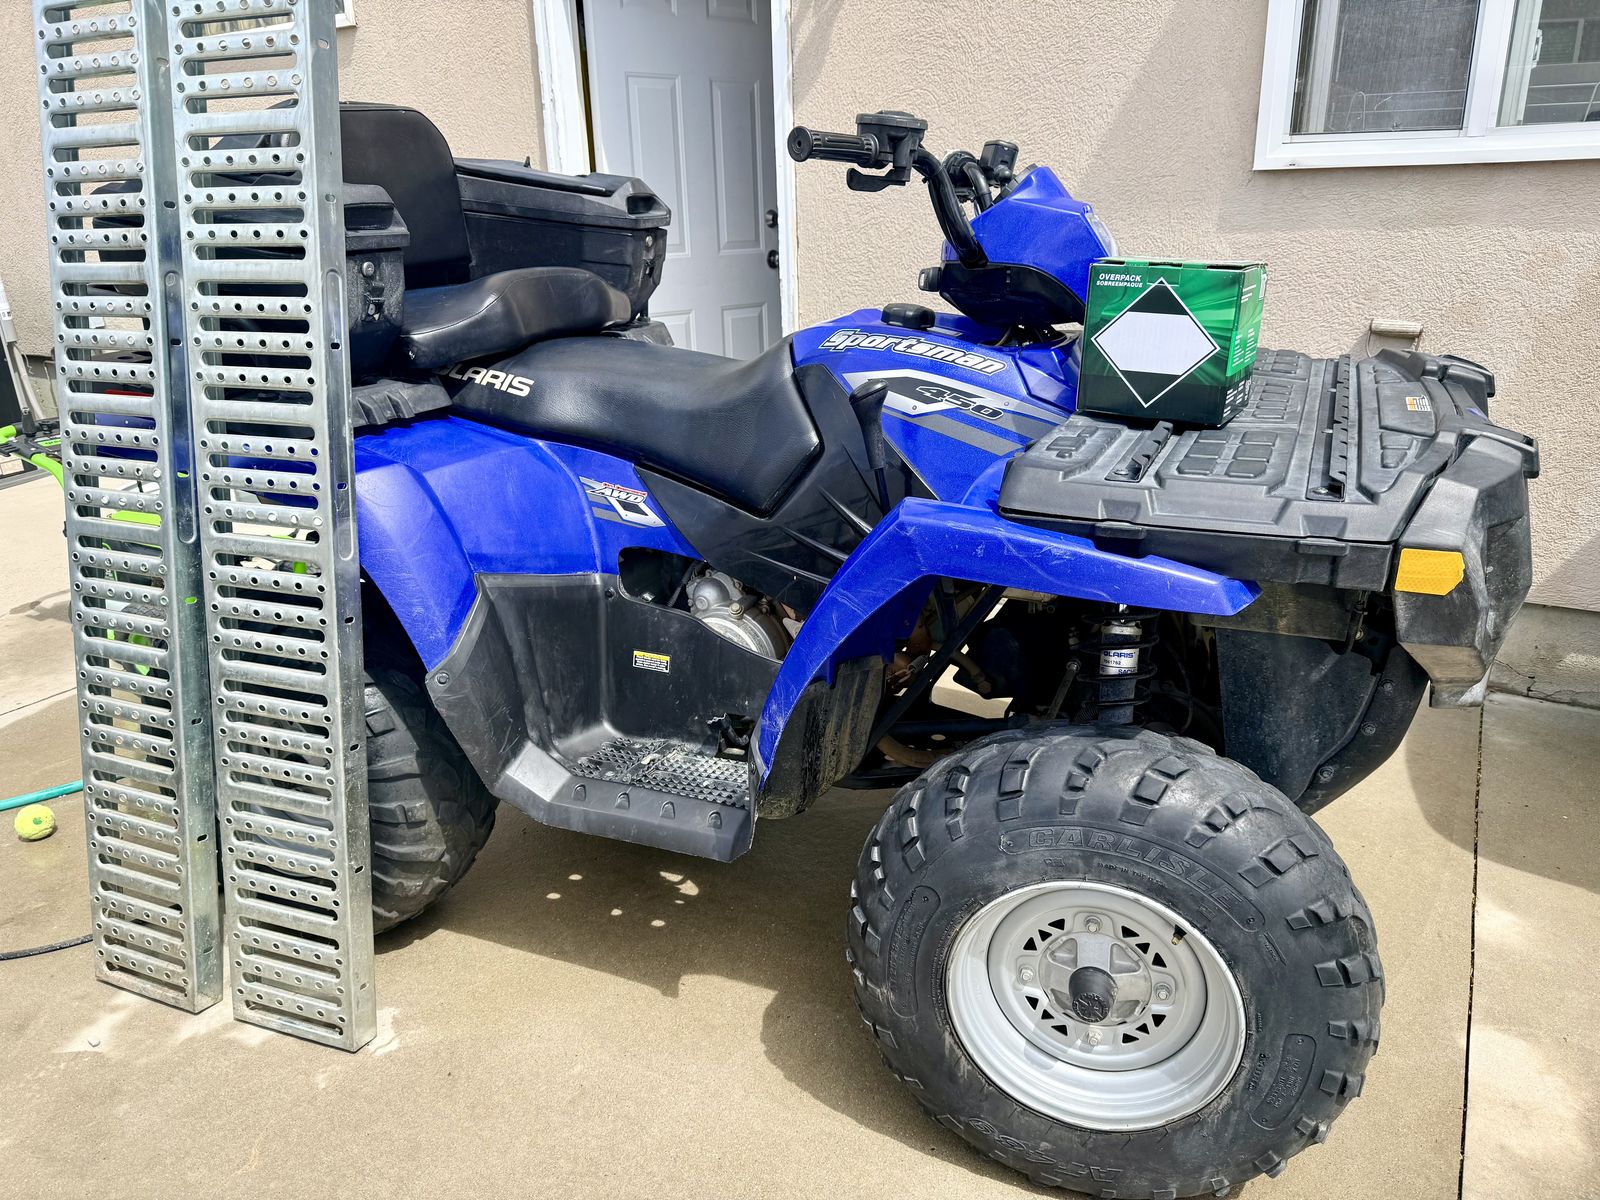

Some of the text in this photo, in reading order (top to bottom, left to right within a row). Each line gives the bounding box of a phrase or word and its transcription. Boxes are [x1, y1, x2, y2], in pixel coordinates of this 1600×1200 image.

[1098, 273, 1142, 282] OVERPACK
[818, 328, 1008, 376] Sportsman
[436, 364, 535, 397] LARIS
[915, 384, 1005, 420] 450
[590, 486, 646, 503] AWD
[1103, 651, 1134, 659] OLARIS
[1028, 828, 1243, 911] CARLISLE
